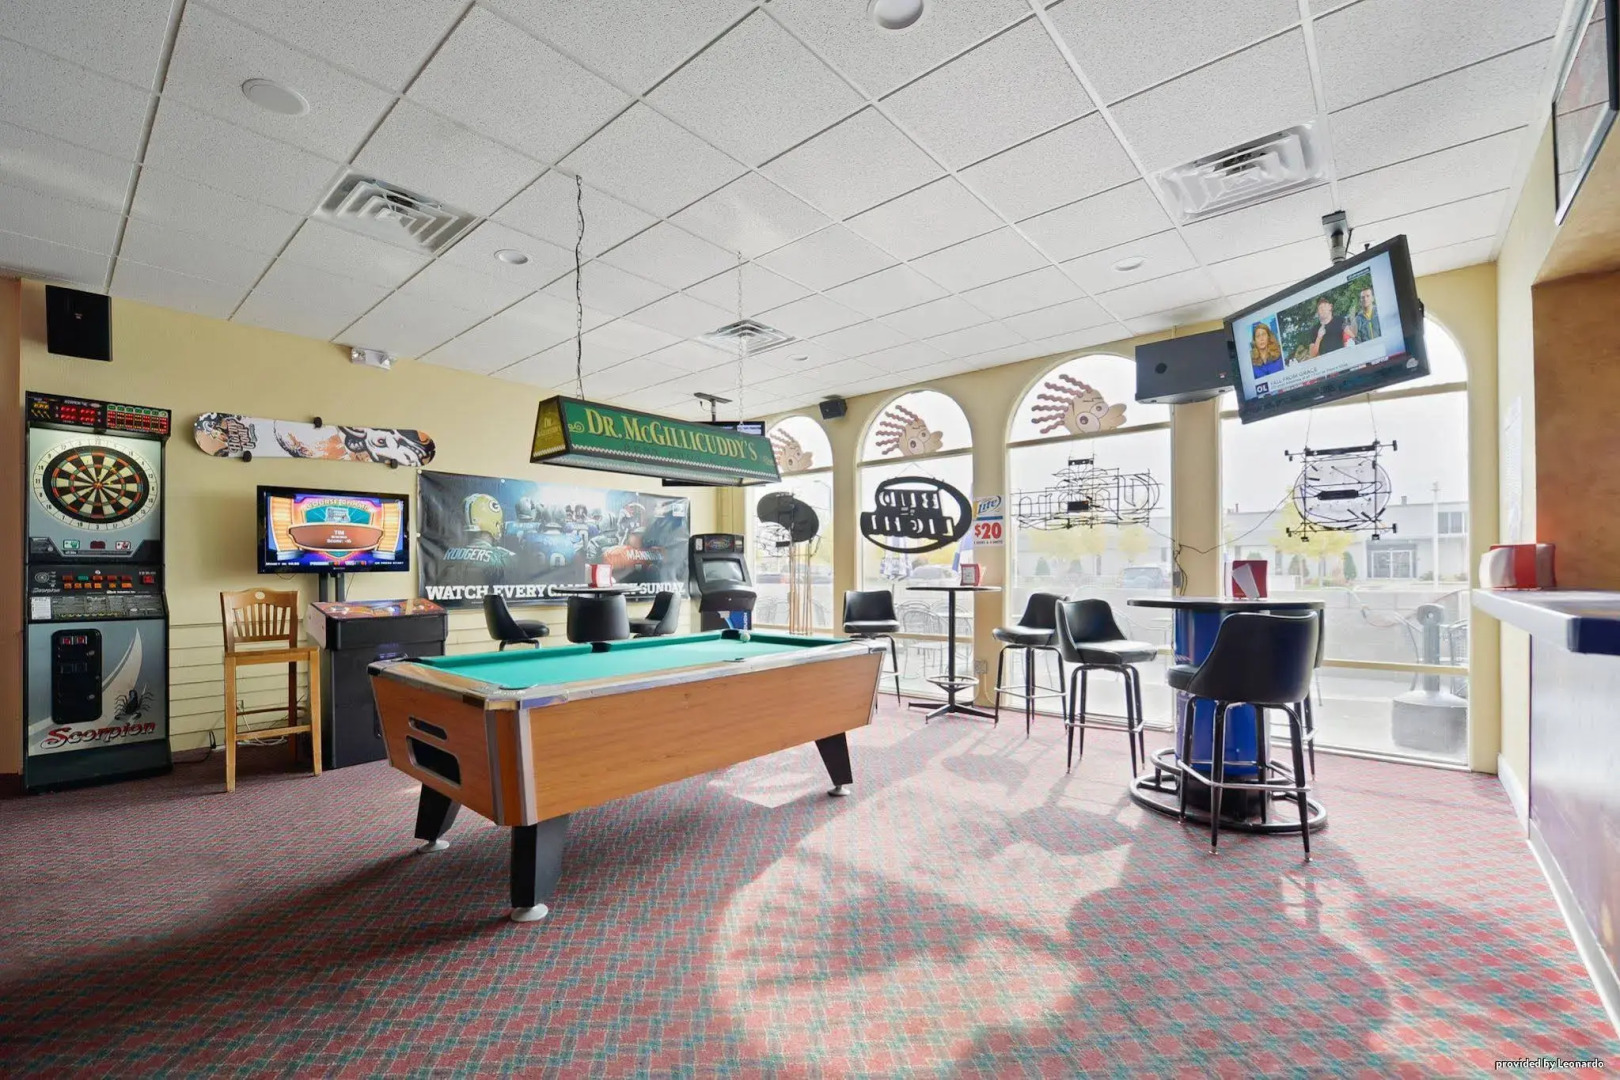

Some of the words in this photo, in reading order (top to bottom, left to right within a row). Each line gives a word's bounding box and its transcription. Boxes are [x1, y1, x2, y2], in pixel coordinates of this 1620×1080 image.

[974, 522, 1002, 539] $20
[443, 547, 494, 562] RODGERS
[425, 585, 488, 600] WATCH
[493, 584, 545, 598] EVERY
[41, 721, 157, 750] Scorpion
